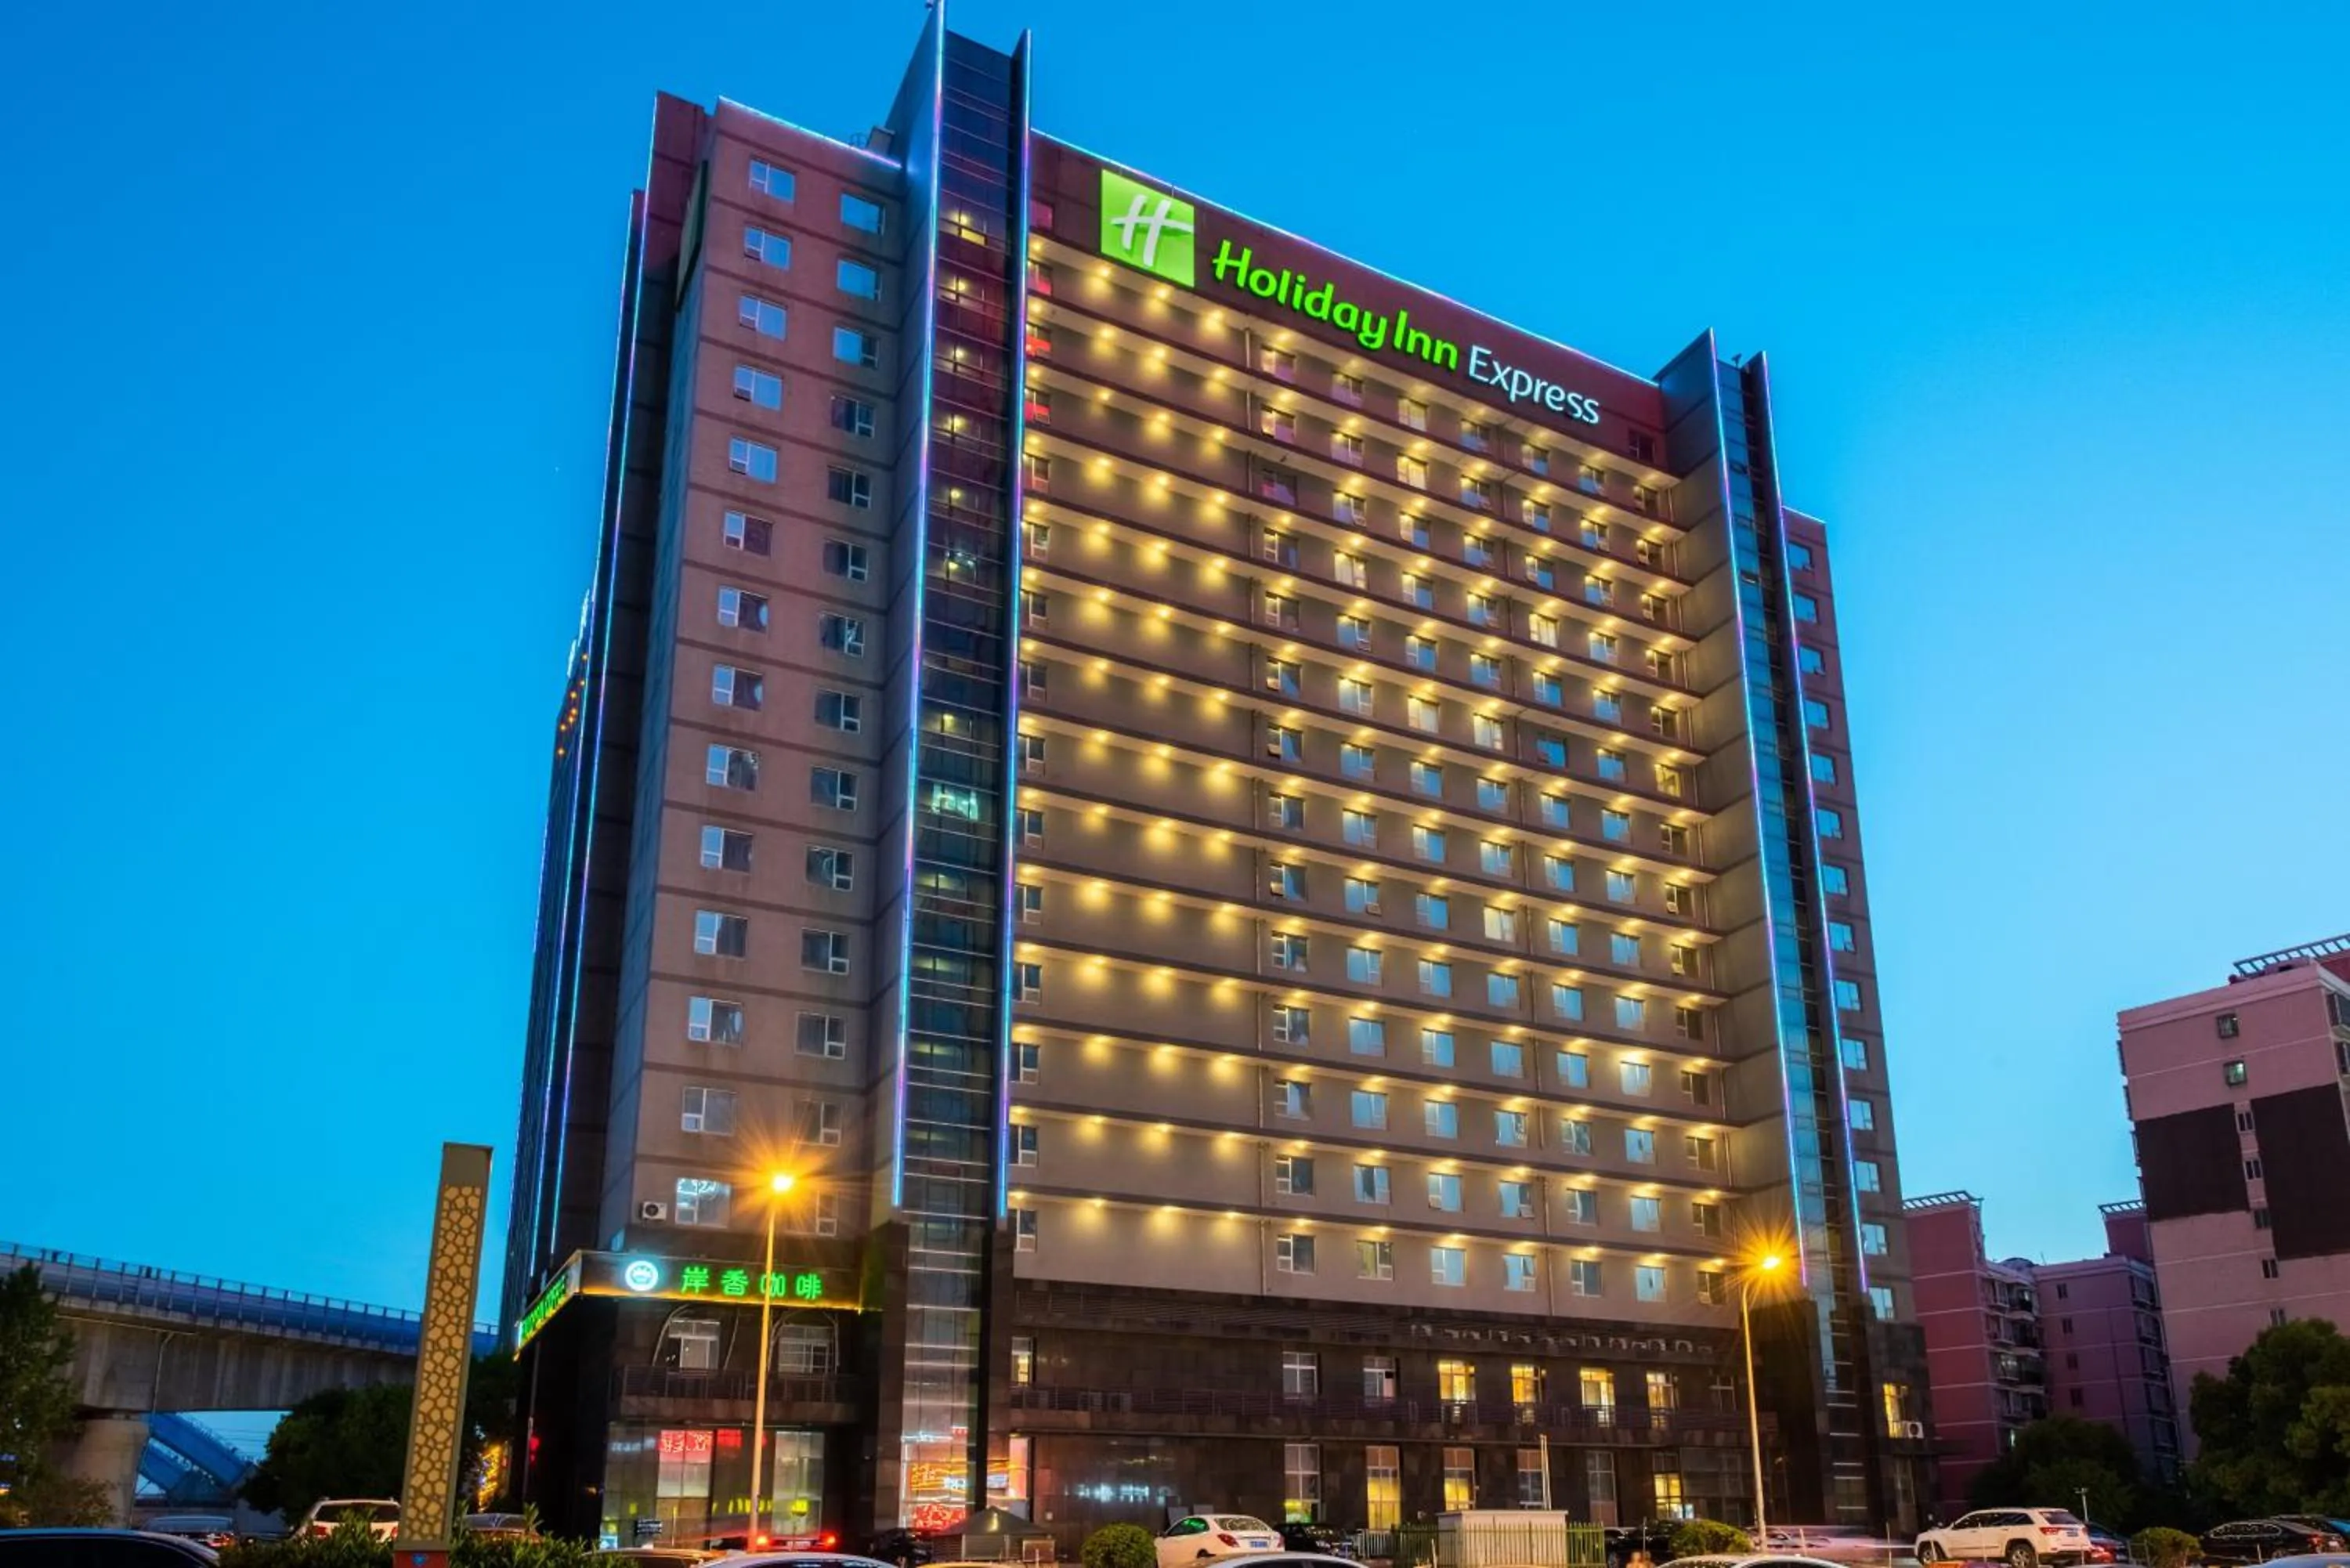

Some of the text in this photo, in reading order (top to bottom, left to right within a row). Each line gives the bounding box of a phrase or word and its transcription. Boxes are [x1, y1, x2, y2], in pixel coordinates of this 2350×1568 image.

[1212, 239, 1600, 424] Holiday Inn Express
[680, 1266, 822, 1300] 岸香咖啡
